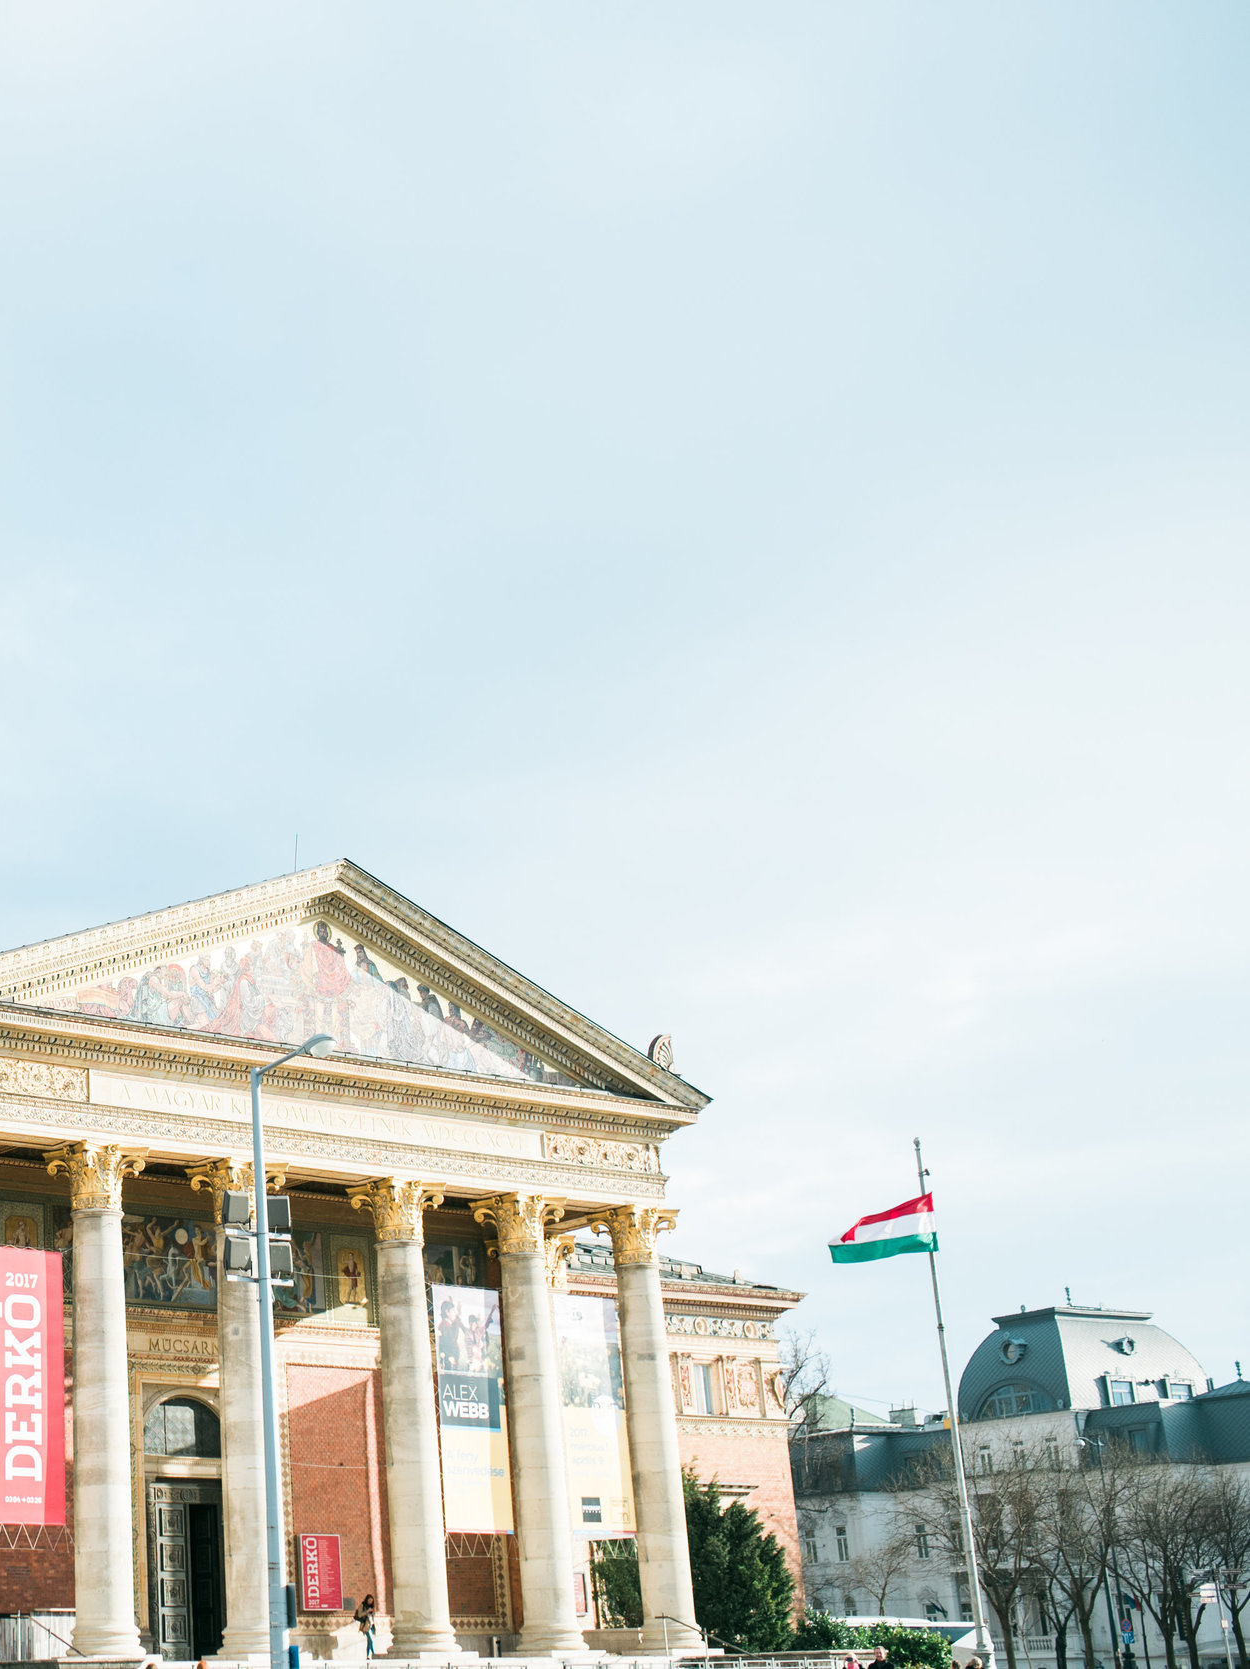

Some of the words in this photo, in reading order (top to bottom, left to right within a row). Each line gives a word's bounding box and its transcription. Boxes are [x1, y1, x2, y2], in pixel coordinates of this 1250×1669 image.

[141, 1086, 221, 1112] MAGYAR
[5, 1272, 38, 1288] 2017
[442, 1383, 479, 1402] ALEX
[442, 1400, 490, 1420] WEBB
